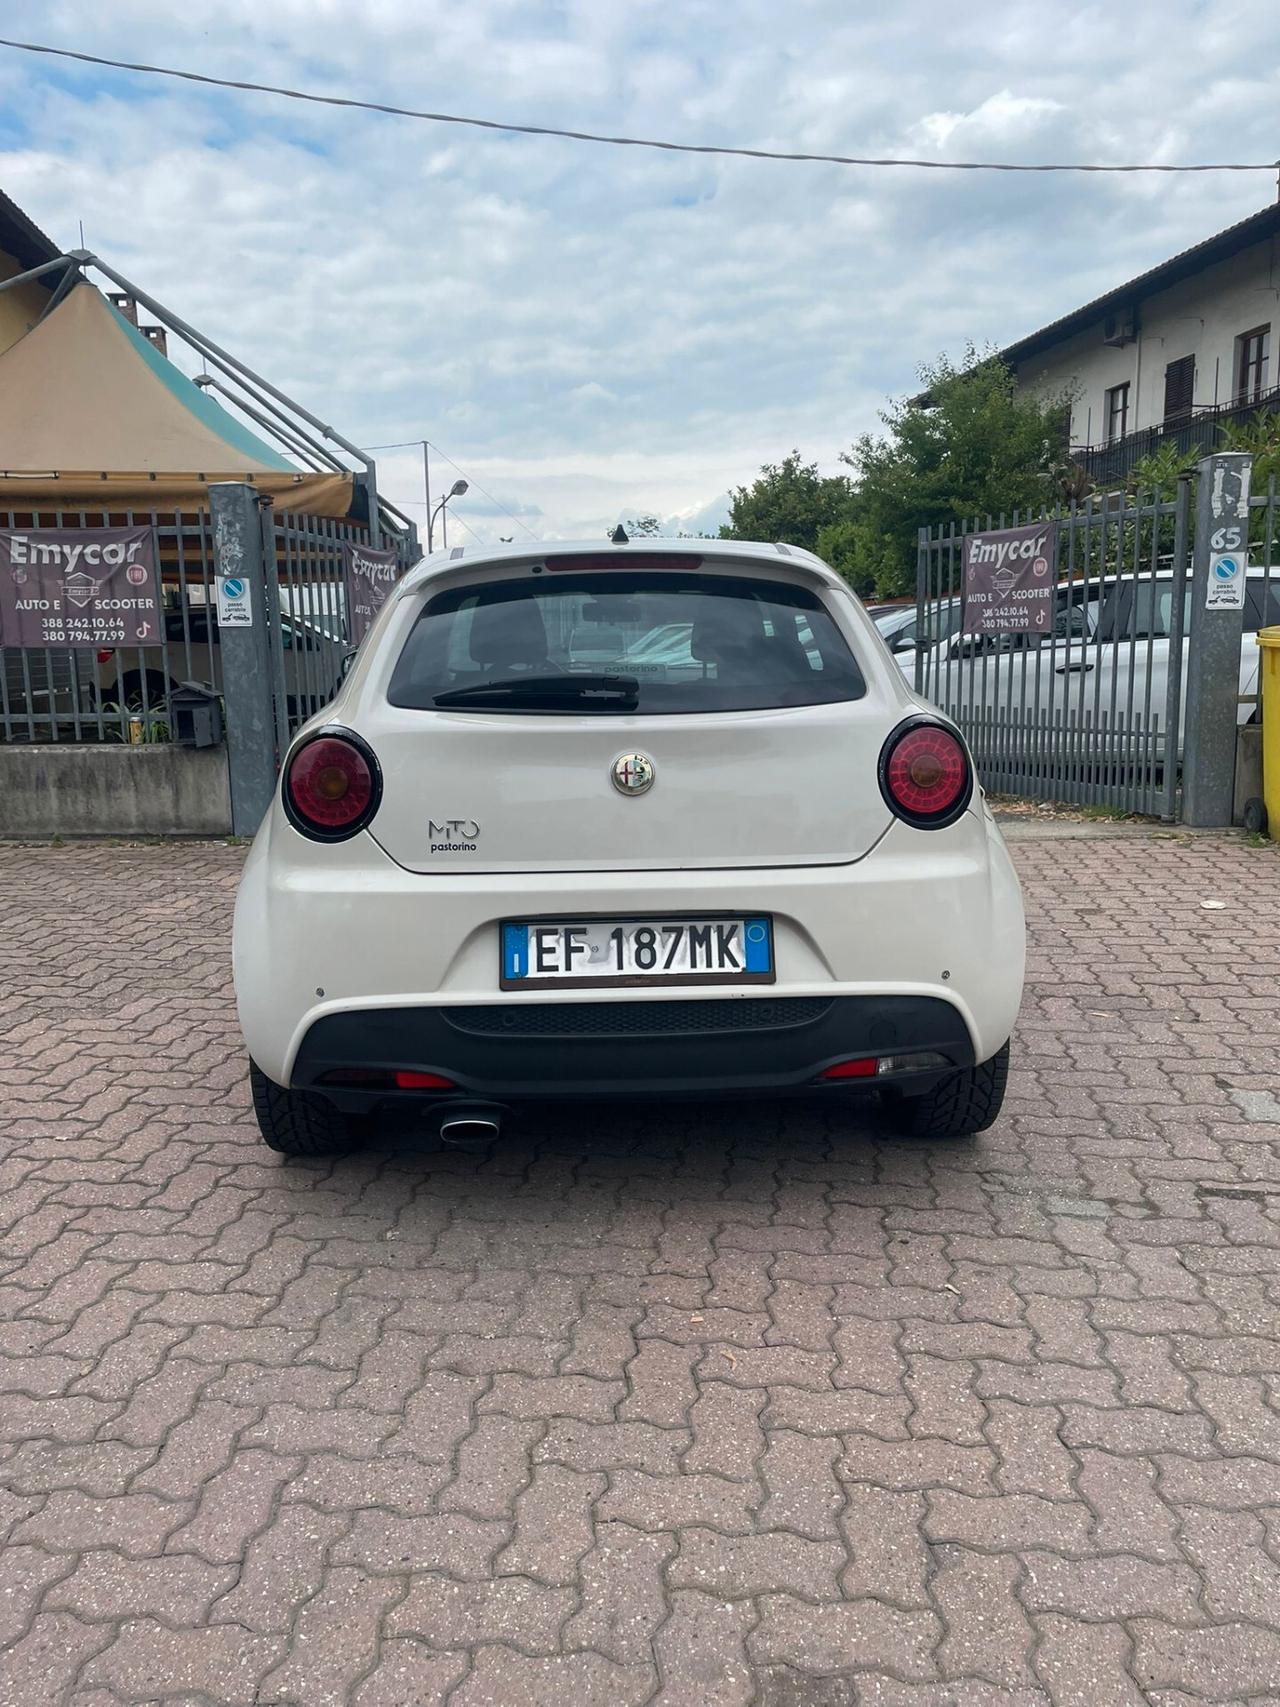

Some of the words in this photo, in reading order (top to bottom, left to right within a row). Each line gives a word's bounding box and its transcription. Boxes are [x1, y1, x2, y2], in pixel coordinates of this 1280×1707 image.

[1210, 526, 1241, 550] 65
[10, 535, 142, 573] Emycar
[969, 536, 1047, 568] Emycar
[968, 593, 986, 603] AUTO
[988, 593, 993, 602] E
[1012, 588, 1050, 600] SCOOTER
[1212, 588, 1237, 596] carrabile
[15, 600, 49, 610] AUTO
[53, 600, 61, 610] E
[94, 599, 154, 610] SCOOTER
[41, 618, 63, 628] 388
[66, 618, 124, 628] 242.10.64
[996, 618, 1029, 628] 794.77.99
[42, 631, 65, 641] 380
[67, 631, 125, 641] 794.77.99
[431, 841, 477, 854] pastorino
[535, 927, 587, 973] EF
[611, 924, 740, 971] 187MK
